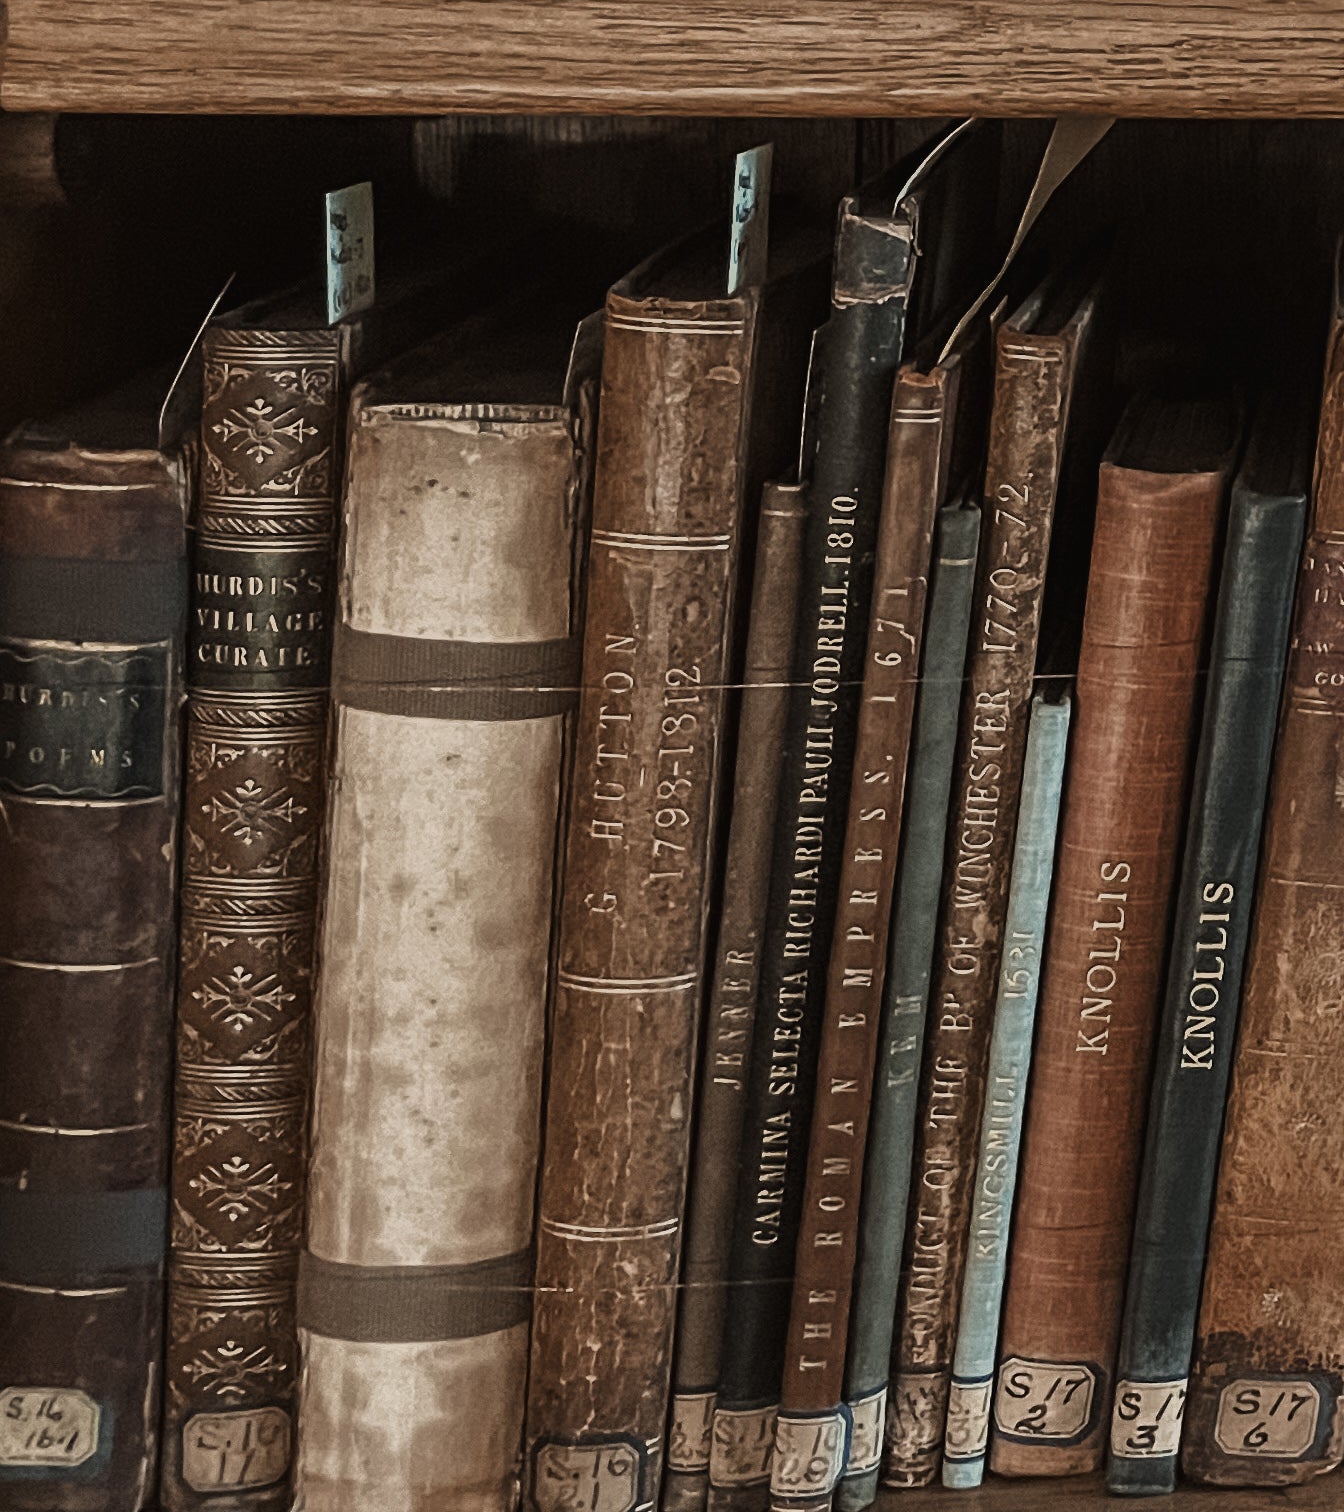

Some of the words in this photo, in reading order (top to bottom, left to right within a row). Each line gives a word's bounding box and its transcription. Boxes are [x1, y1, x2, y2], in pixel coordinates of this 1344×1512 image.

[196, 568, 324, 596] HURDIS'S
[196, 607, 324, 634] VILLAGE
[197, 644, 314, 667] CURATE
[803, 726, 836, 804] PAULI
[953, 688, 1010, 910] WINCHESTER
[585, 890, 619, 913] G
[783, 815, 826, 958] RICHARDI
[837, 754, 895, 1029] EMPRESS.
[947, 935, 979, 976] OF
[1075, 861, 1131, 1056] KNOLLIS
[1180, 880, 1235, 1071] KNOLLIS
[769, 969, 811, 1095] SELECTA
[926, 1054, 967, 1129] THE
[752, 1108, 795, 1245] CARMINA
[813, 1077, 858, 1248] ROMAN
[922, 1147, 961, 1189] OF
[973, 1063, 1020, 1259] KINGSMILL
[799, 1289, 837, 1371] THE
[1005, 1370, 1033, 1401] S
[1044, 1375, 1090, 1406] 17
[1117, 1391, 1143, 1421] S
[1232, 1387, 1260, 1415] S
[1270, 1394, 1314, 1422] 17
[1014, 1404, 1048, 1435] 2
[1126, 1425, 1156, 1451] 3
[1242, 1422, 1269, 1449] 6
